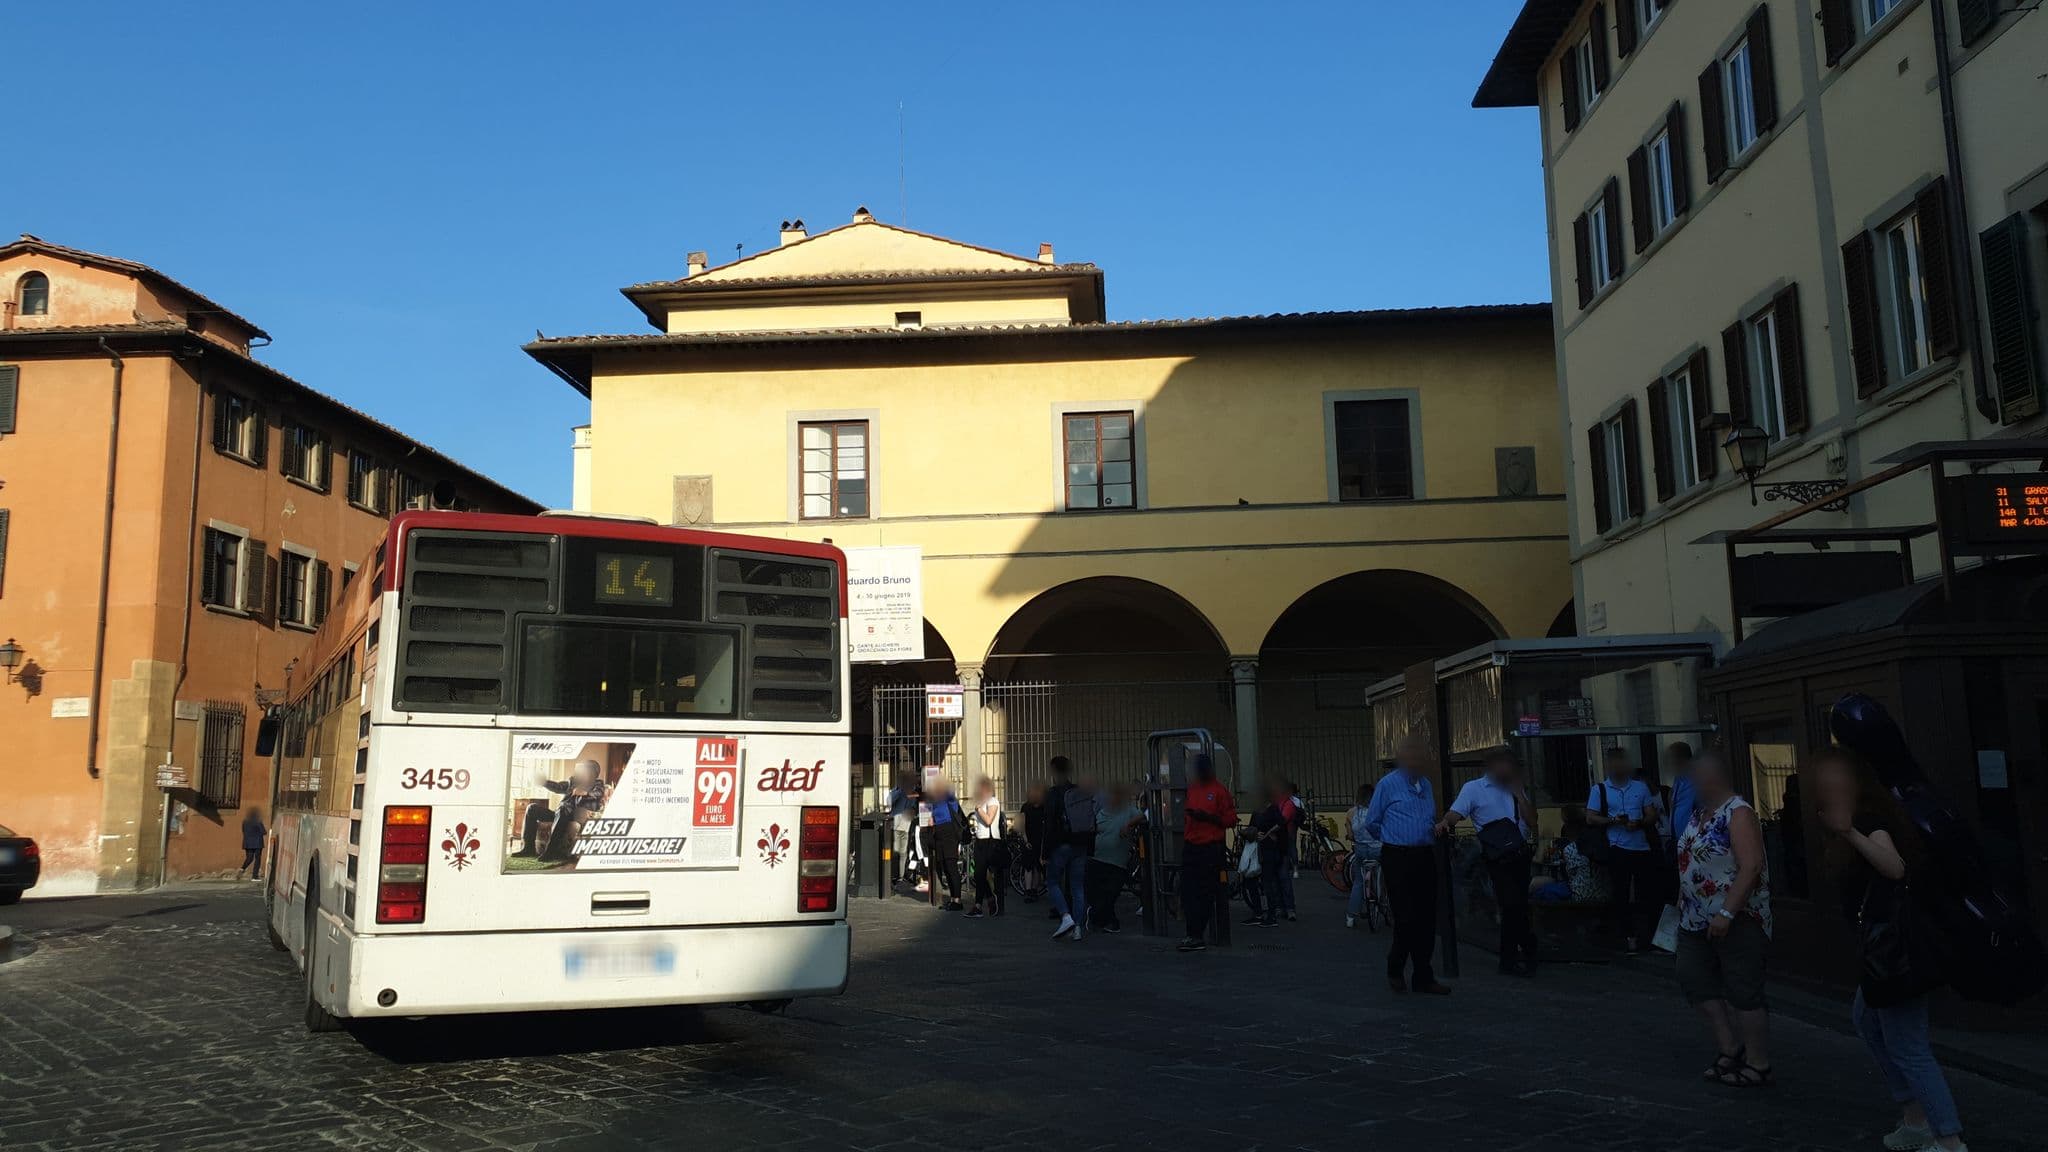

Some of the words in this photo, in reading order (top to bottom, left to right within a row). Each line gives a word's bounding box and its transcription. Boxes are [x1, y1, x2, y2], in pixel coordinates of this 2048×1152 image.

[1996, 488, 2007, 496] 31
[2025, 487, 2048, 495] GRAS
[1999, 498, 2009, 506] 11
[2000, 508, 2017, 516] 14A
[606, 559, 656, 596] 14
[847, 577, 880, 585] duardo
[882, 576, 911, 585] Bruno
[645, 768, 684, 776] ASSICURAZIONE
[757, 758, 826, 792] ataf
[401, 767, 471, 790] 3459
[697, 771, 733, 804] 99
[644, 796, 661, 804] FURTO
[705, 805, 723, 814] EURO
[700, 815, 709, 824] AL
[710, 814, 727, 823] MESE
[581, 819, 630, 836] BASTA
[571, 838, 681, 855] IMPROVVISARE!
